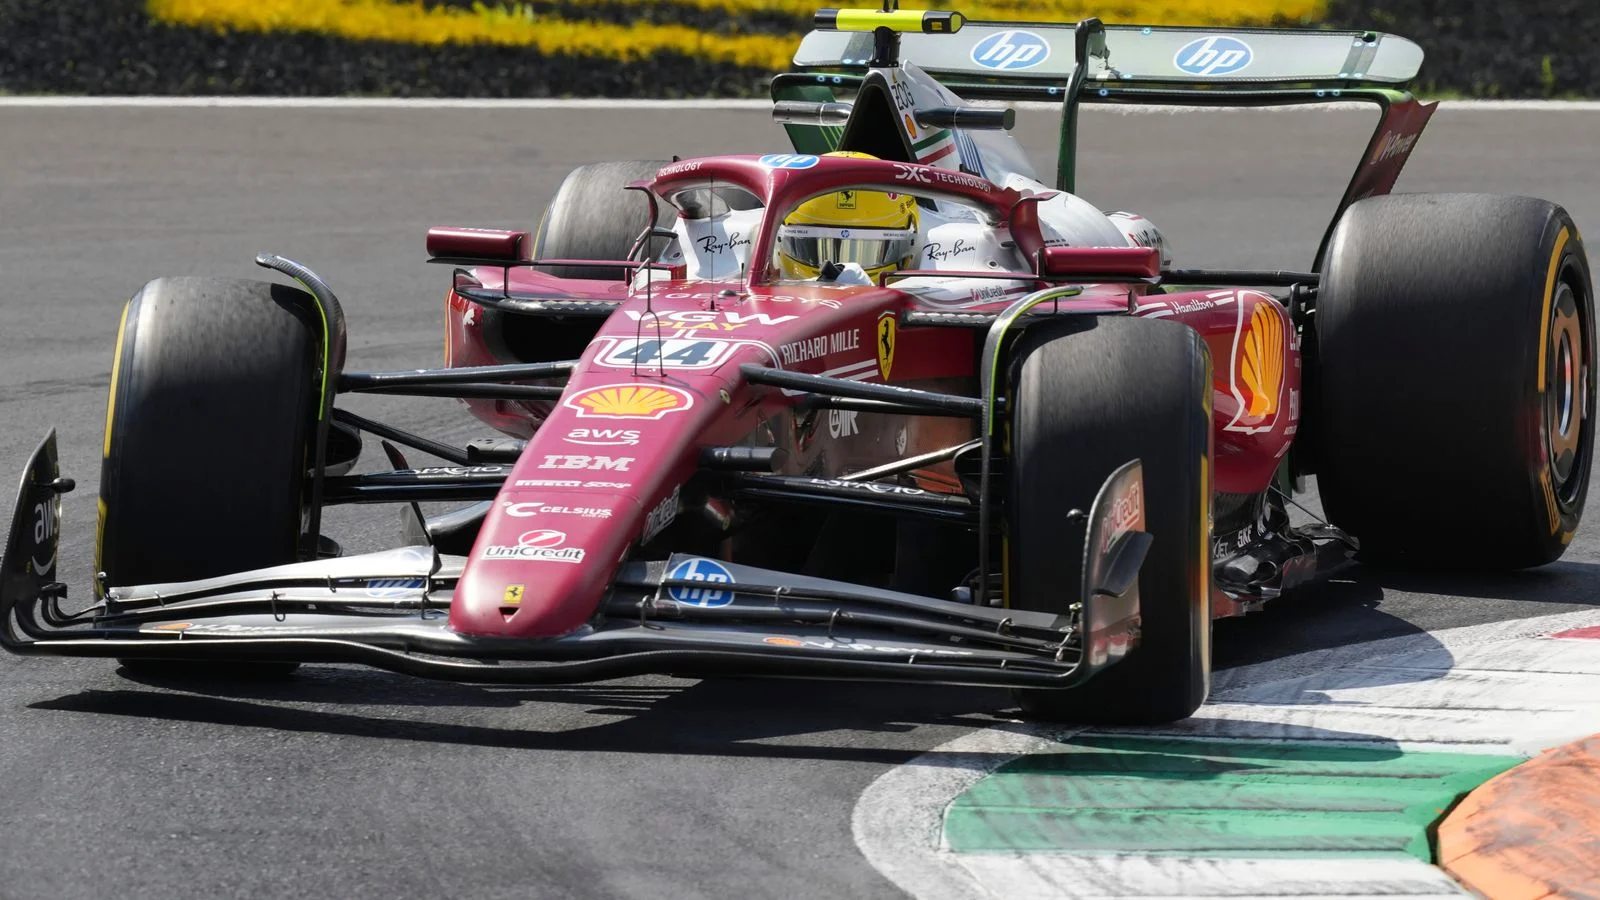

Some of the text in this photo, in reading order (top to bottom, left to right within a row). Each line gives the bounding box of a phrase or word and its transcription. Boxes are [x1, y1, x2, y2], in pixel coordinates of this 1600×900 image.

[978, 30, 1043, 70] hp
[1182, 36, 1246, 76] hp
[893, 164, 992, 194] DXC TECHNOLOGY
[696, 232, 751, 254] Ray-Ban
[922, 239, 976, 261] Ray-Ban
[1170, 298, 1214, 315] Hamilton
[624, 310, 800, 326] VGW
[644, 320, 748, 332] PLAY
[614, 340, 711, 365] 44
[780, 328, 860, 366] RICHARD MILLE
[567, 428, 641, 440] aws
[537, 454, 635, 472] IBM
[540, 506, 612, 517] CELSIUS
[485, 544, 584, 562] UniCredit
